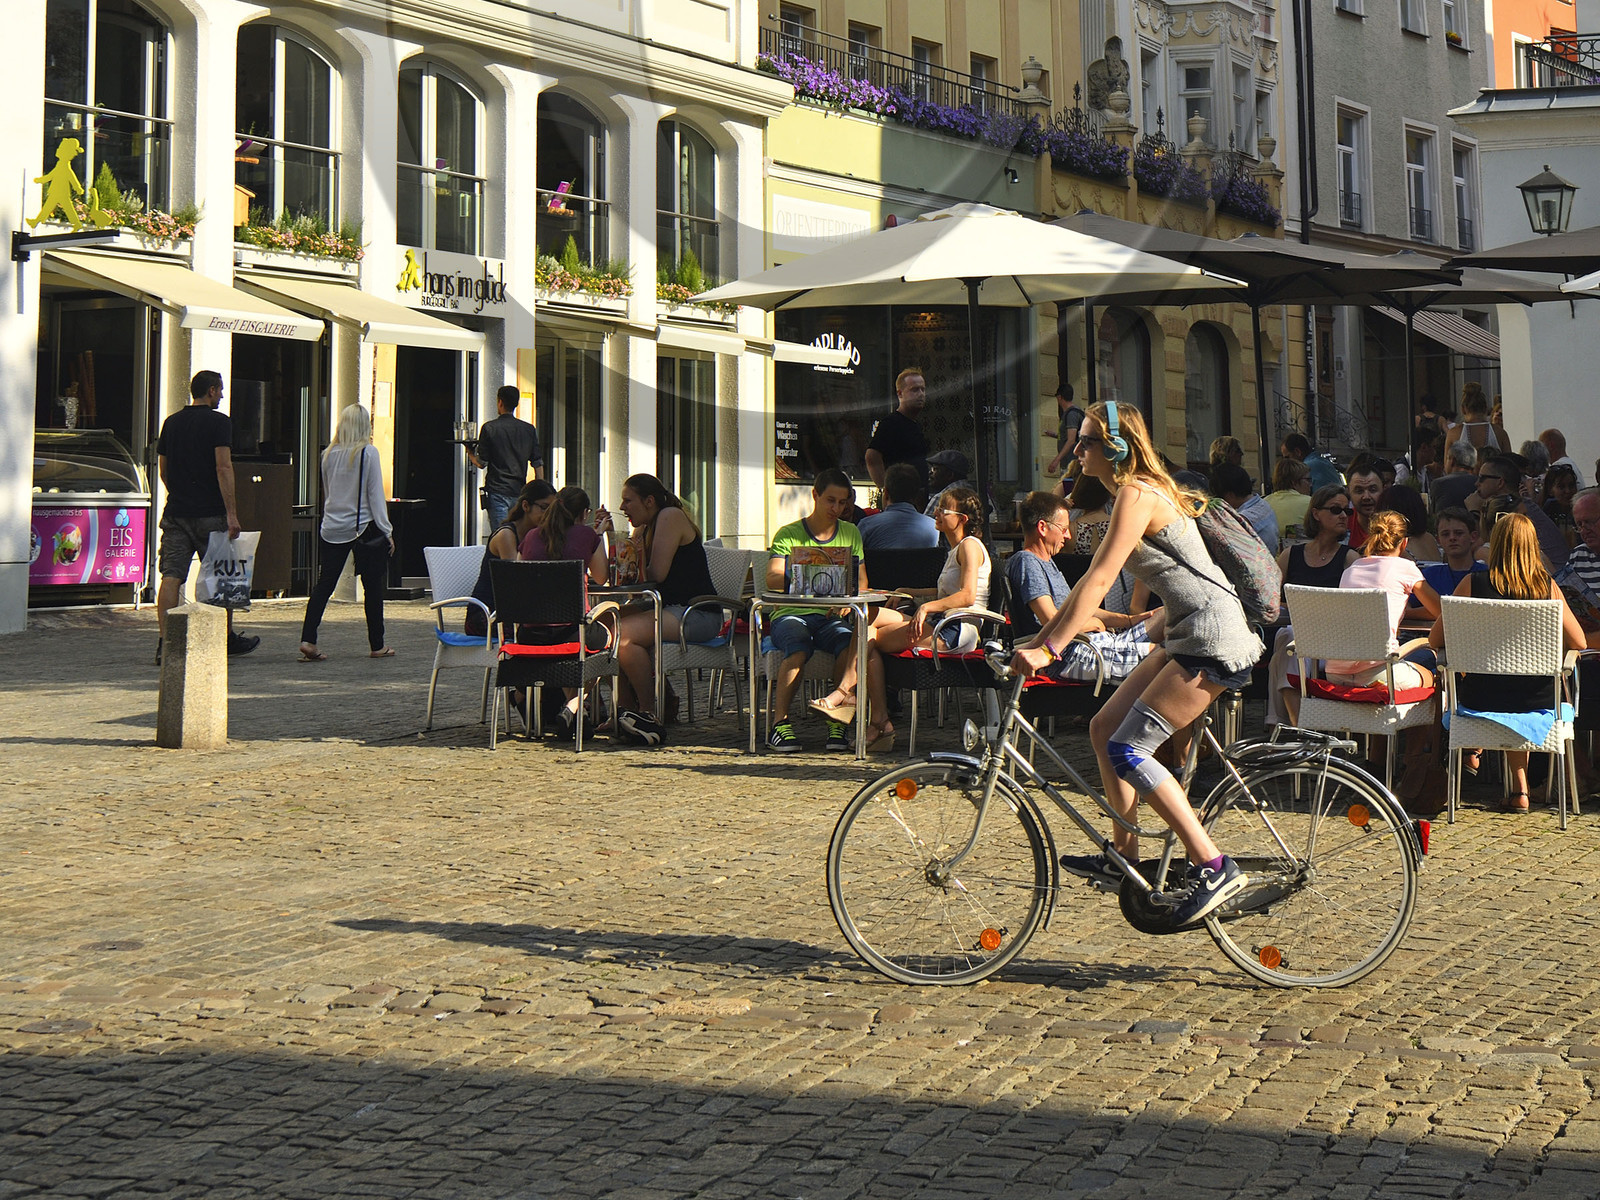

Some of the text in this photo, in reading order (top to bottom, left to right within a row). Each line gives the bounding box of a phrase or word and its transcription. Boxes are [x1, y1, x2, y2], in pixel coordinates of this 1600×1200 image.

[422, 252, 454, 298] hans
[456, 271, 473, 298] im
[239, 320, 297, 336] EISGALERIE
[838, 334, 861, 366] RAD
[776, 430, 798, 440] Waschen
[110, 528, 133, 547] EIS
[105, 549, 136, 558] GALERIE
